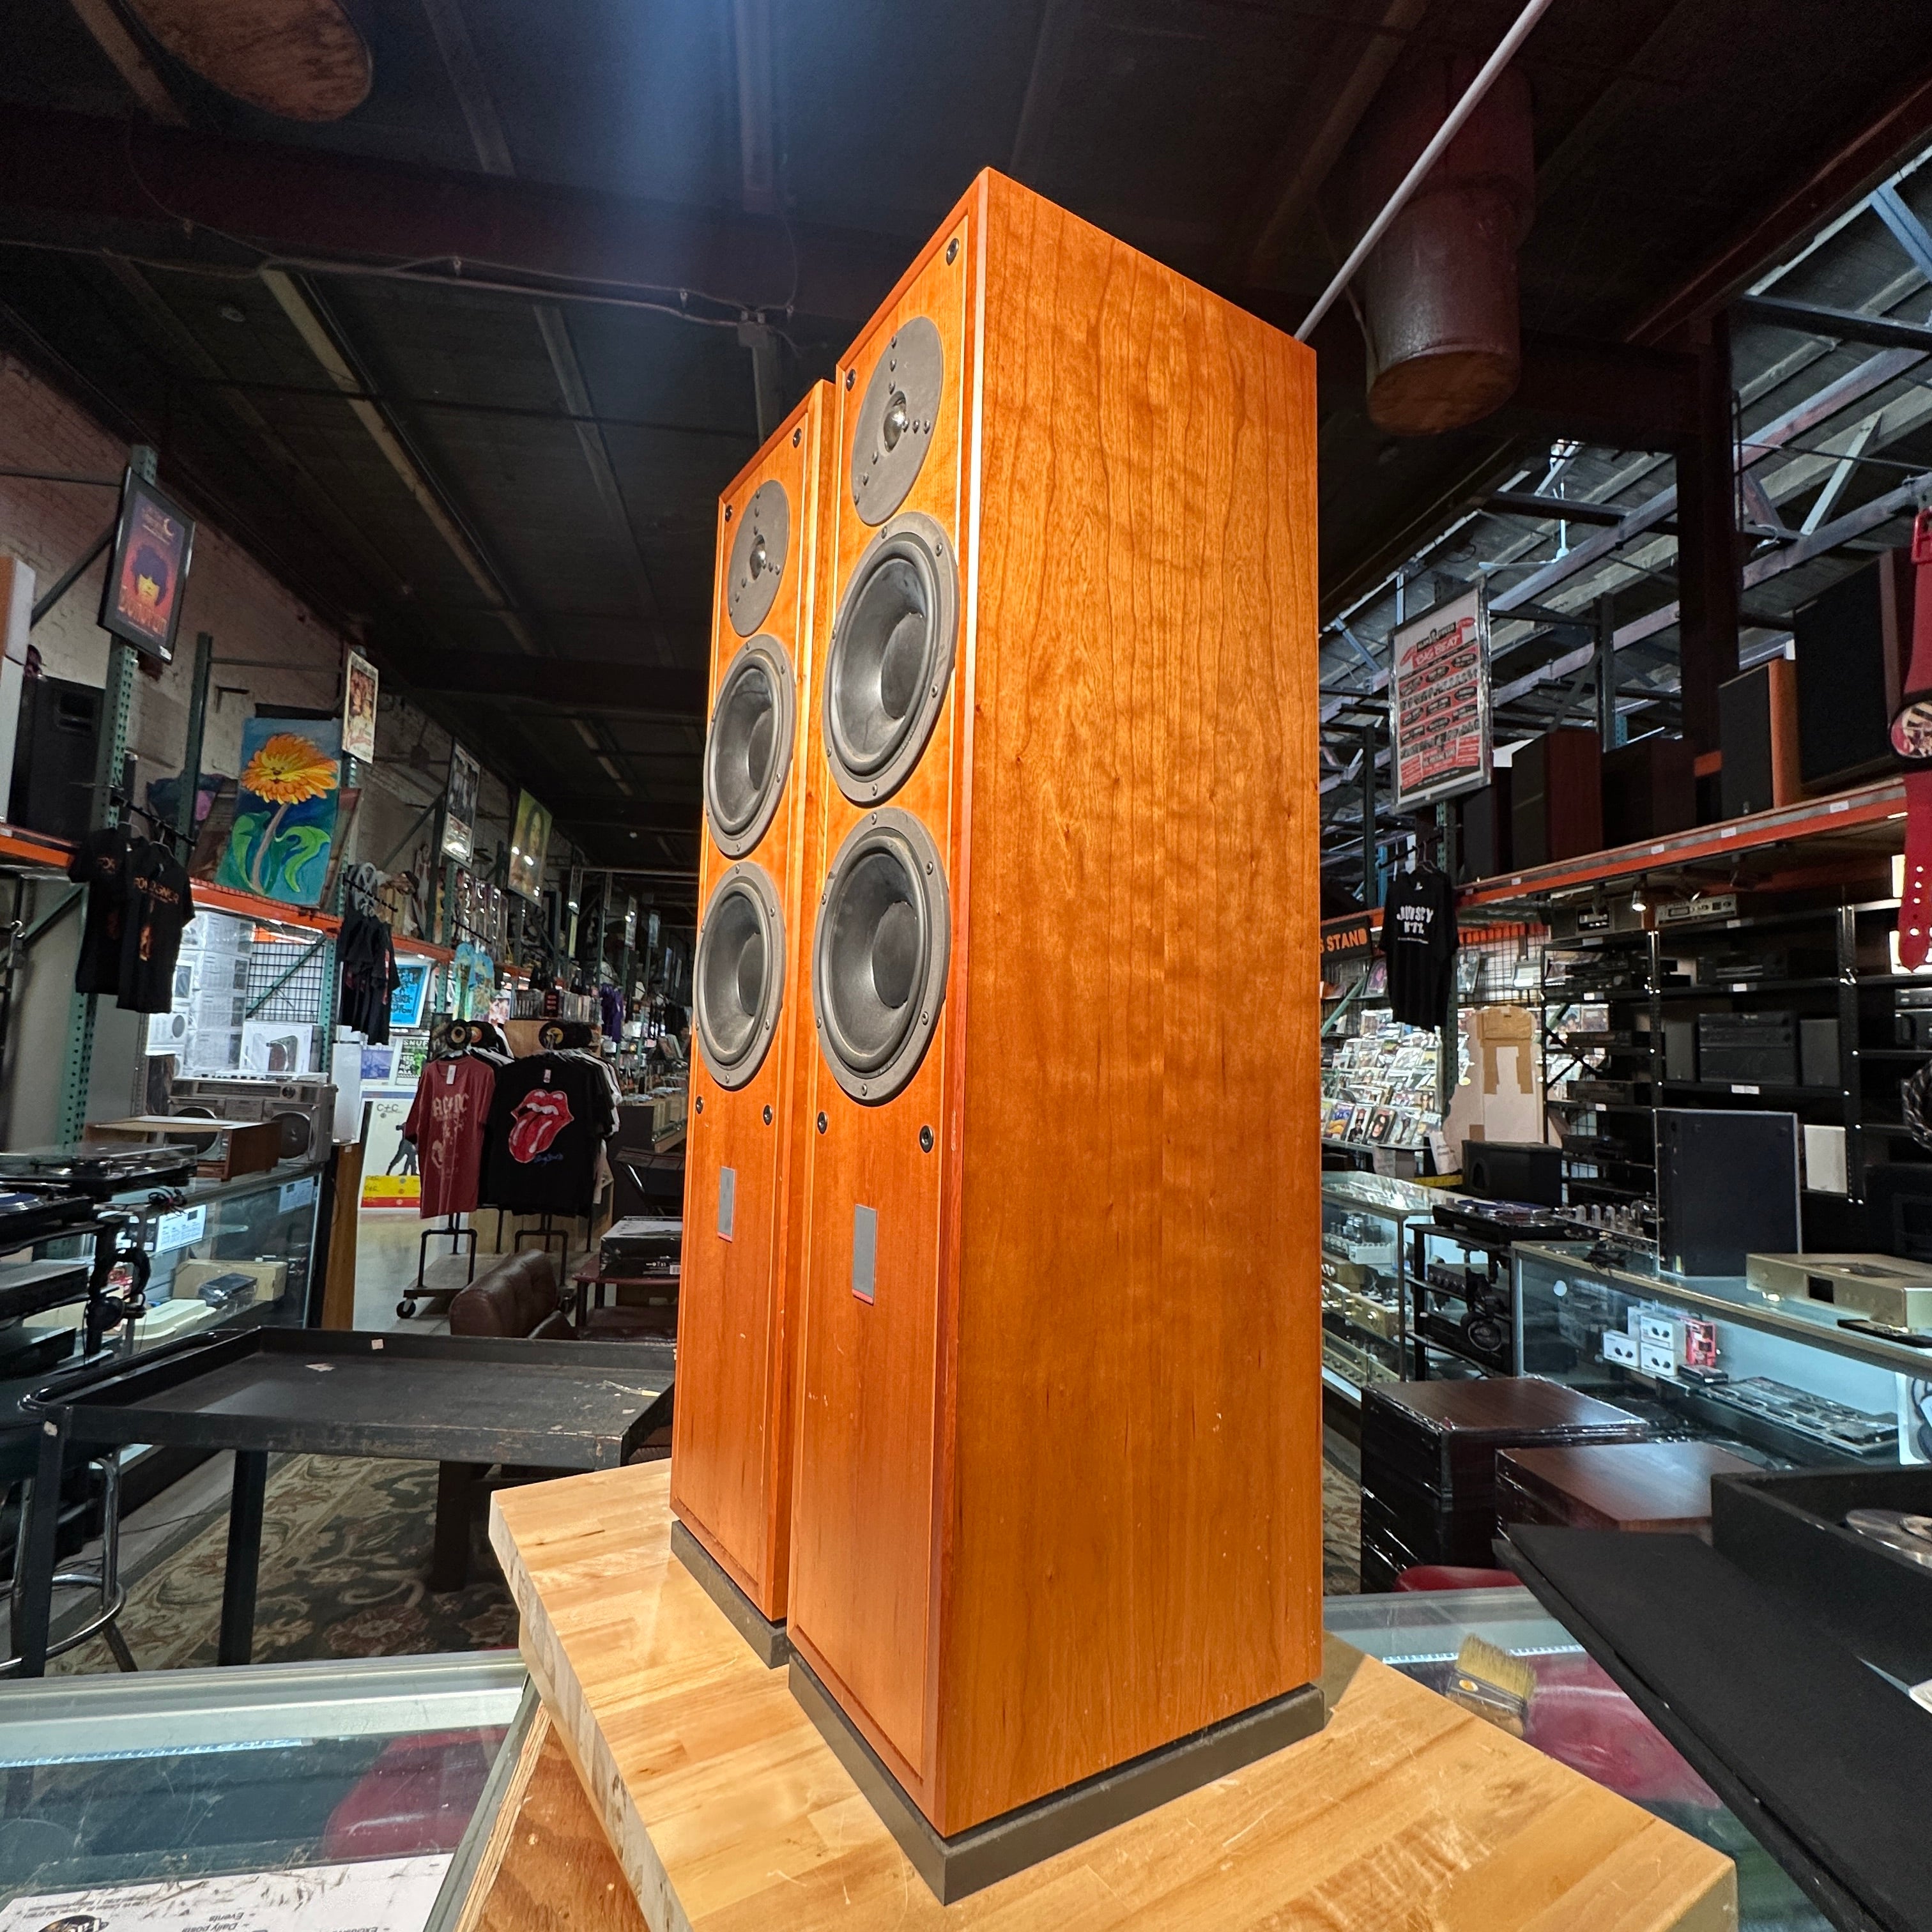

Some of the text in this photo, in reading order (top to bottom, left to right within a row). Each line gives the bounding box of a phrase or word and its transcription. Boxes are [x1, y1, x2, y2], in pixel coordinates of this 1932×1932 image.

[1326, 928, 1367, 952] STAND
[208, 1912, 244, 1922] Events
[210, 1922, 240, 1931] Daily
